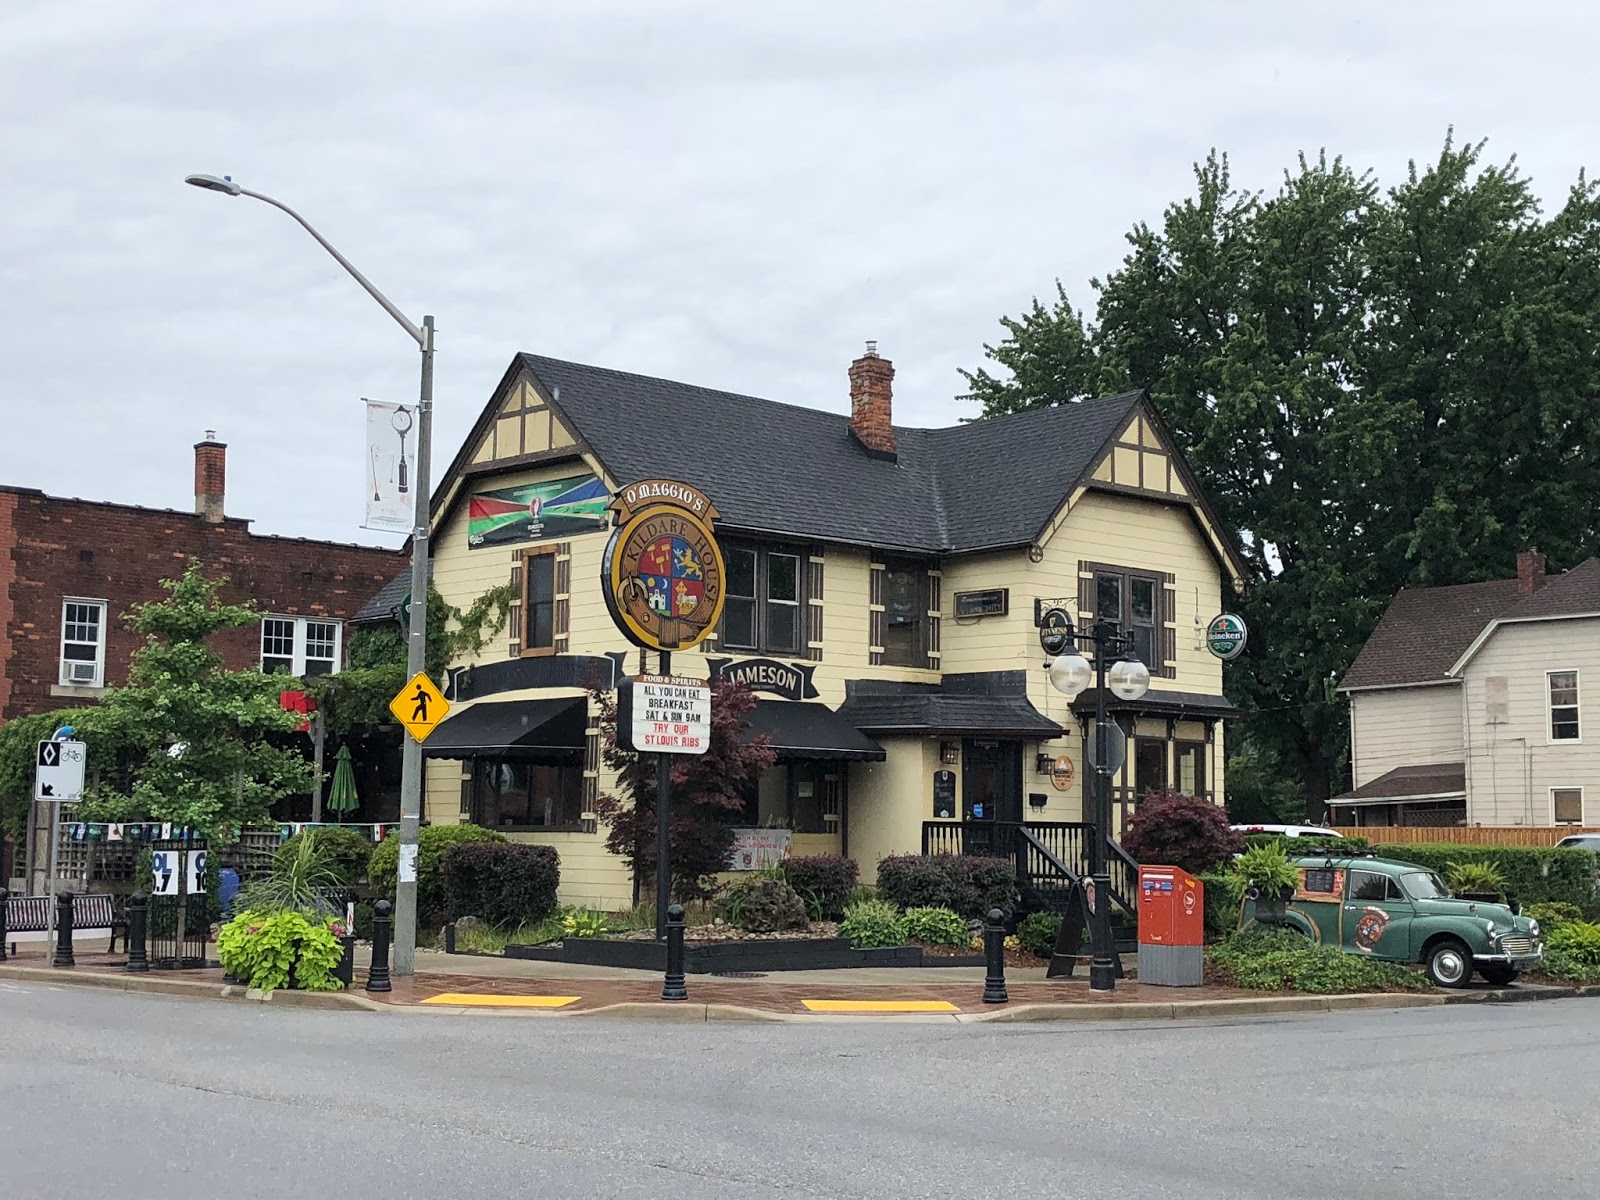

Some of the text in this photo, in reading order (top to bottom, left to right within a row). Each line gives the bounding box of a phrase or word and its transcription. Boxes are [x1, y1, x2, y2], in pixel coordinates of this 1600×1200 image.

[627, 483, 703, 511] O'MAGGIO'S
[627, 519, 718, 606] KILDARE HOUSE
[643, 674, 663, 683] FOOD
[671, 677, 701, 686] SPIRITS
[730, 666, 796, 690] JAMESON
[643, 685, 700, 700] ALL YOU CAN EAT
[648, 698, 694, 711] BREAKFAST
[645, 710, 659, 721] SAT
[670, 712, 683, 722] SUN
[685, 713, 701, 723] 9AM
[653, 723, 689, 735] TRY OUR
[644, 734, 700, 748] ST LOUIS RIBS
